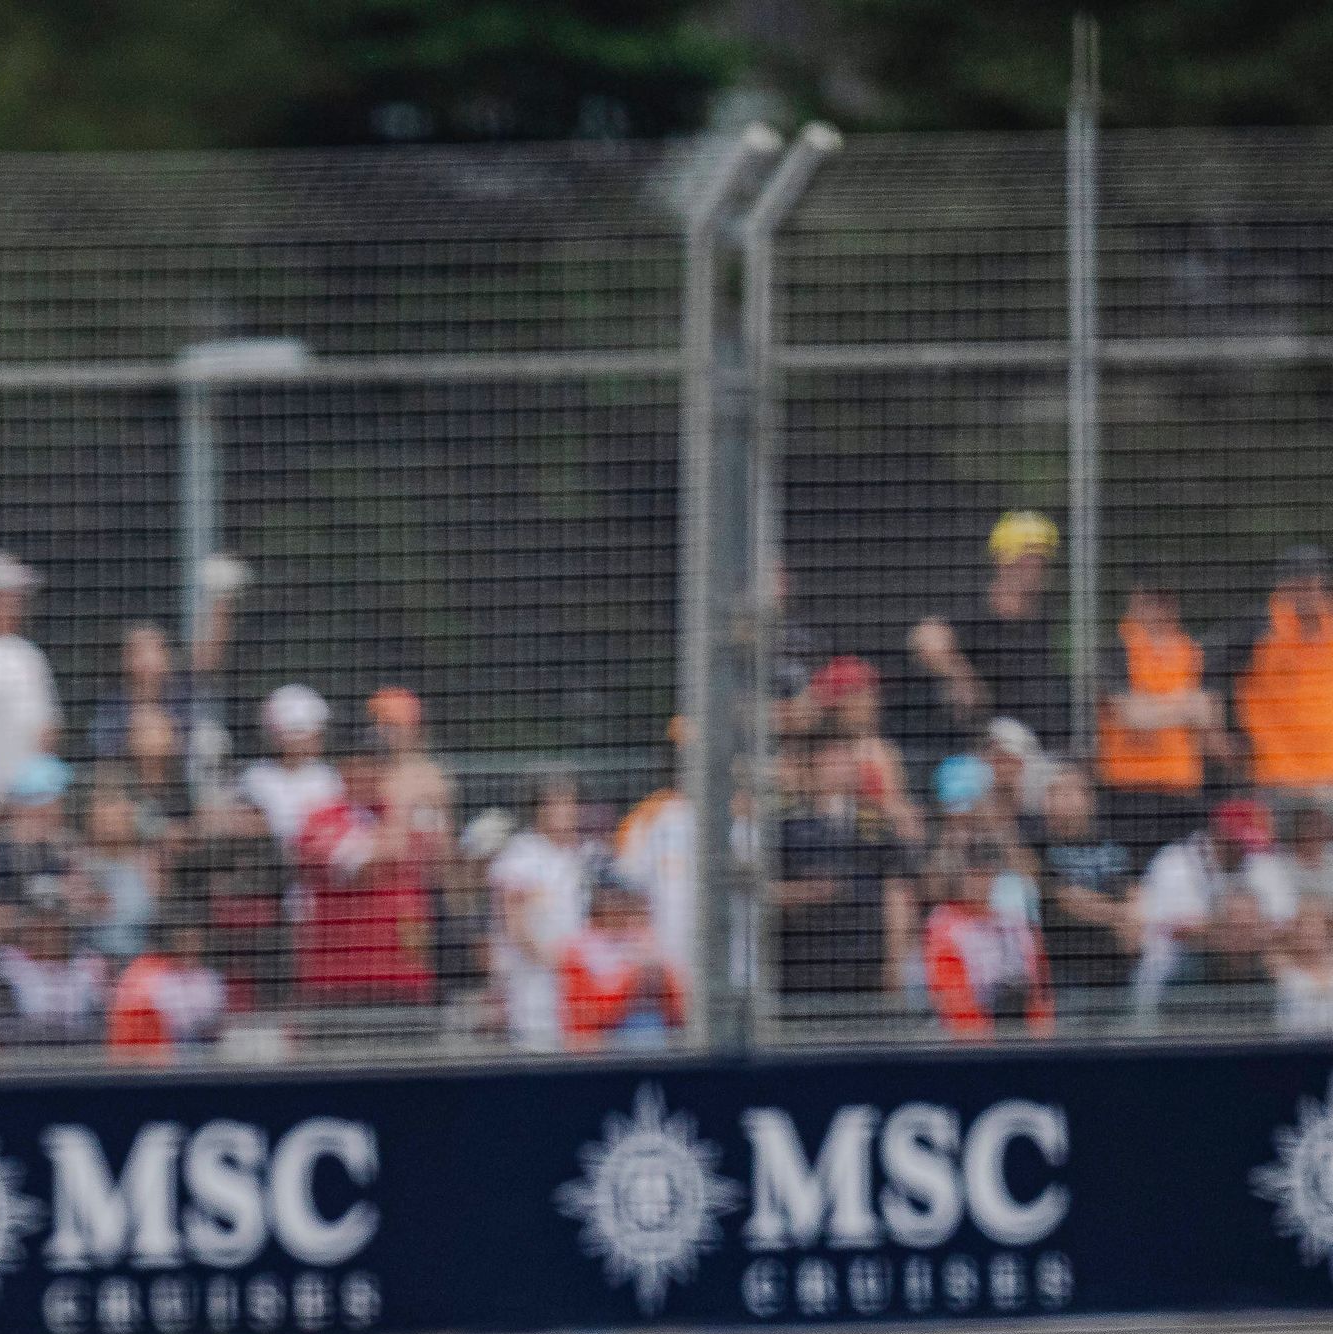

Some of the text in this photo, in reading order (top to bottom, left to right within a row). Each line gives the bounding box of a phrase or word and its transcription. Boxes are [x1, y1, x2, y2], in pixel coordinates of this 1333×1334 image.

[40, 1117, 381, 1270] MSC
[741, 1100, 1071, 1250] MSC
[740, 1252, 1075, 1316] CRUISES
